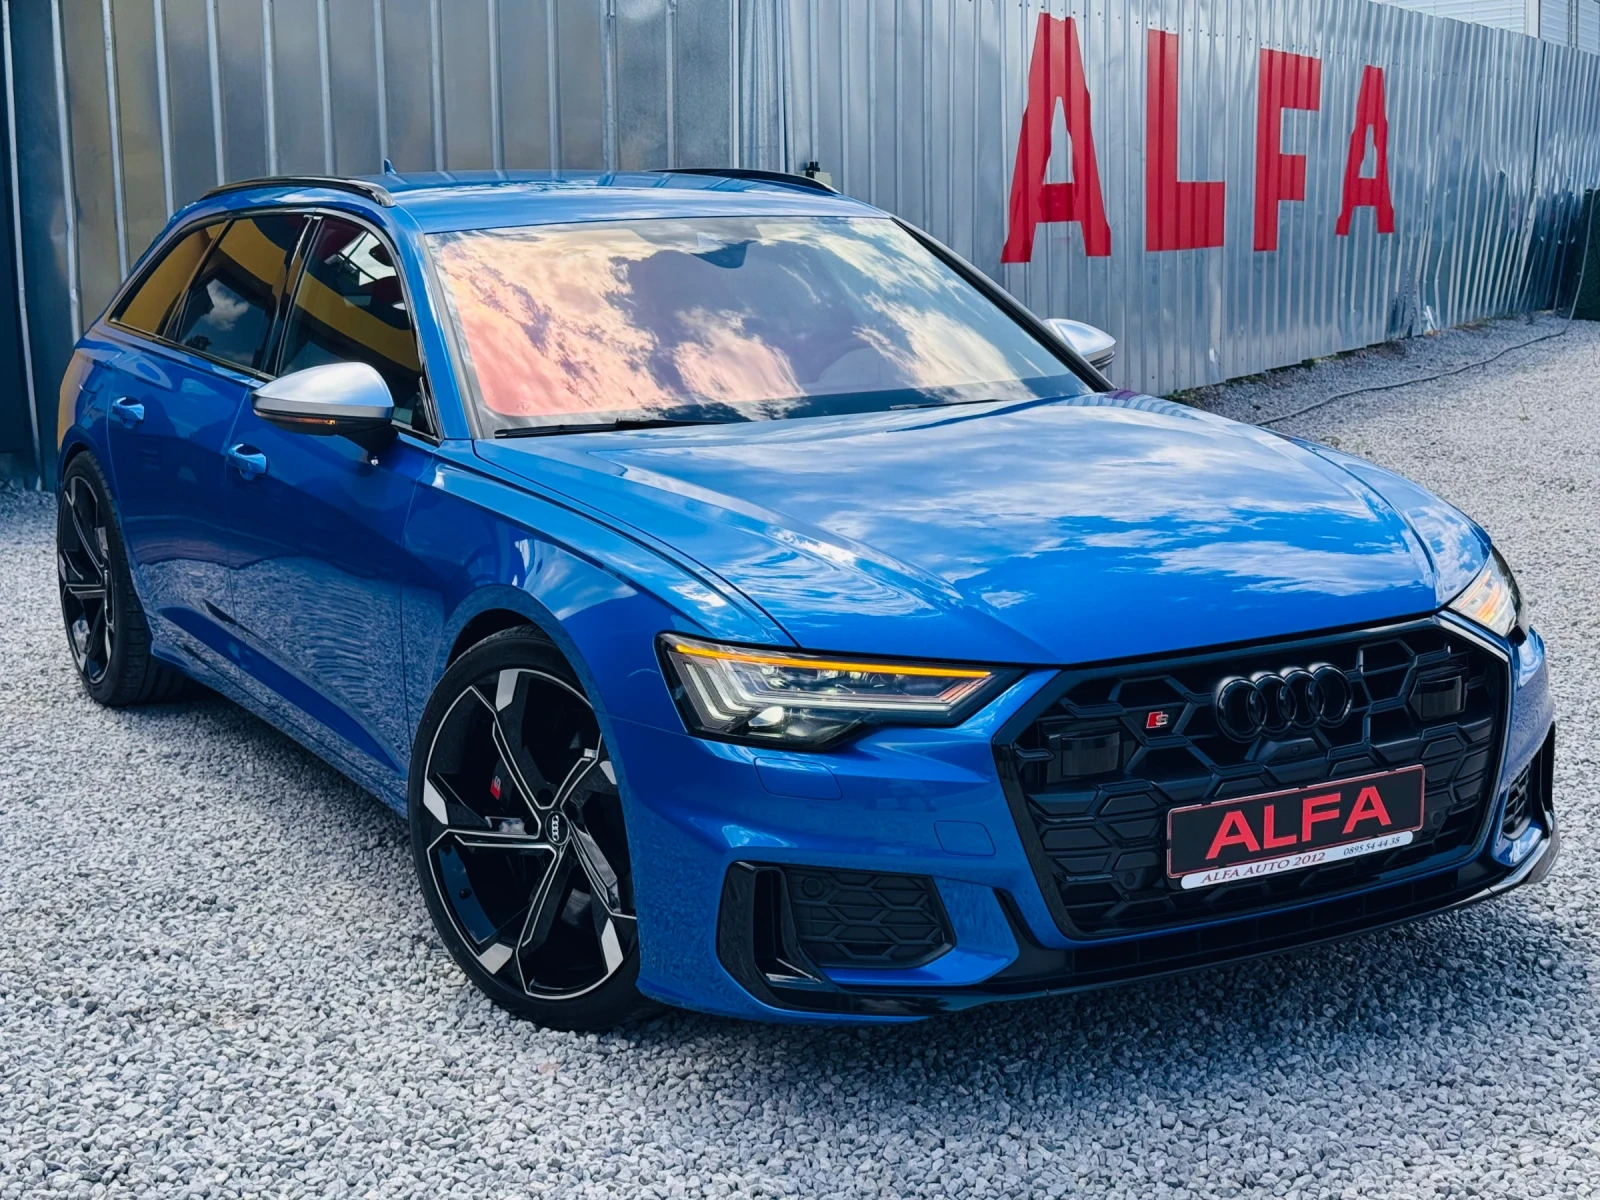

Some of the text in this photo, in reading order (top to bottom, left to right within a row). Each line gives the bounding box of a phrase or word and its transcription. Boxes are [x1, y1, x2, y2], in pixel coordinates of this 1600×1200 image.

[1001, 12, 1395, 264] ALFA
[1201, 836, 1401, 884] ALFA AUTO 2012 0895 54 44 38
[1205, 786, 1392, 860] ALFA
